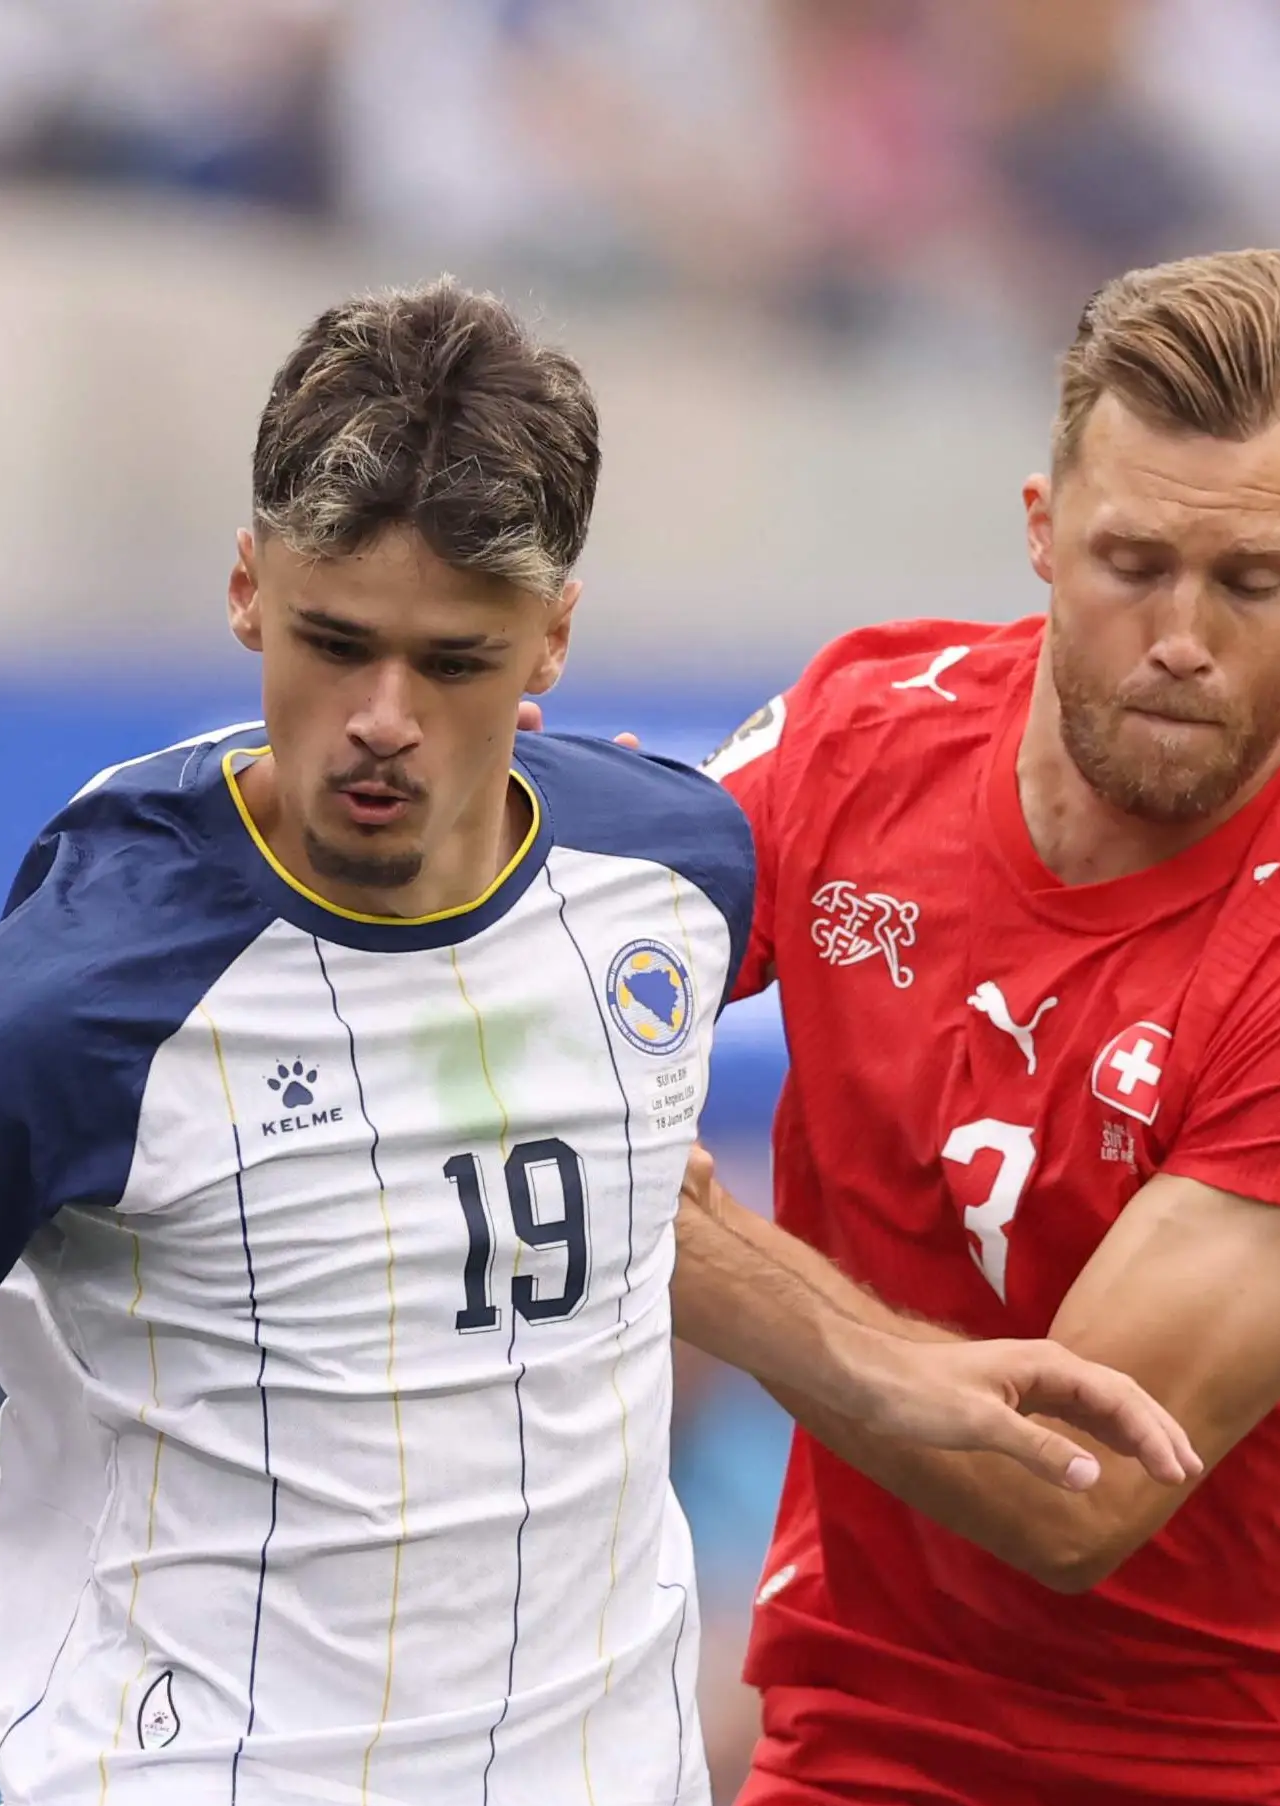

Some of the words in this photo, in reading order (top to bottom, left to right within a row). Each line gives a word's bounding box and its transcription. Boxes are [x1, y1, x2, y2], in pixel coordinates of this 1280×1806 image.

[262, 1107, 344, 1137] KELME
[941, 1117, 1037, 1306] 3
[443, 1137, 593, 1335] 19
